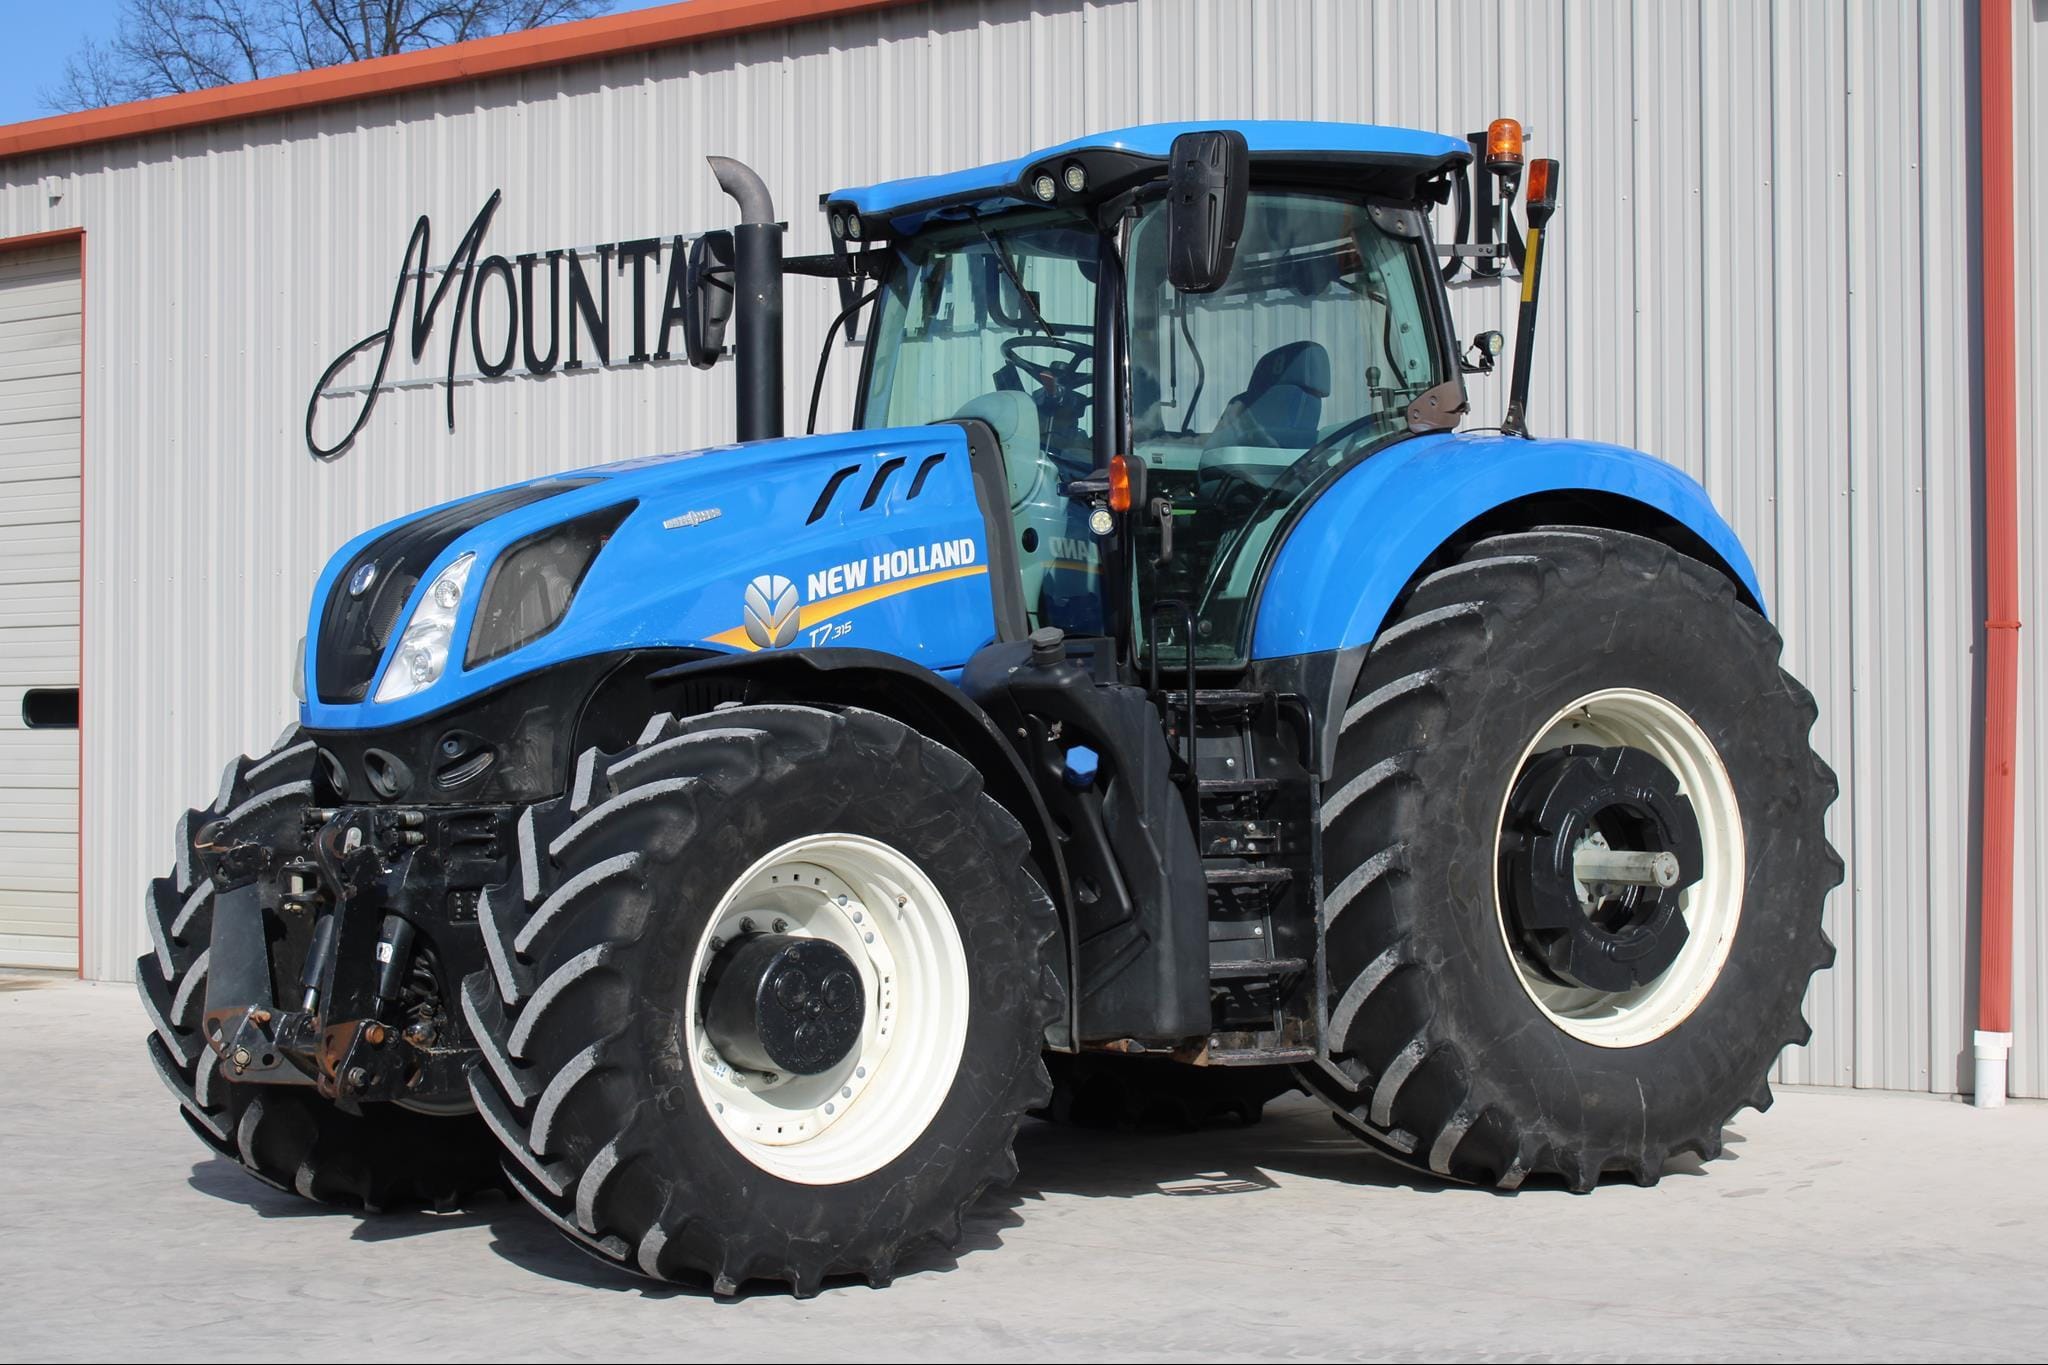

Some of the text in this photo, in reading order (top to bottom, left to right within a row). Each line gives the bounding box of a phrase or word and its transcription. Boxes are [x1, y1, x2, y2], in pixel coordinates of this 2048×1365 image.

[305, 187, 788, 457] MOUNTA
[807, 538, 976, 602] NEW HOLLAND
